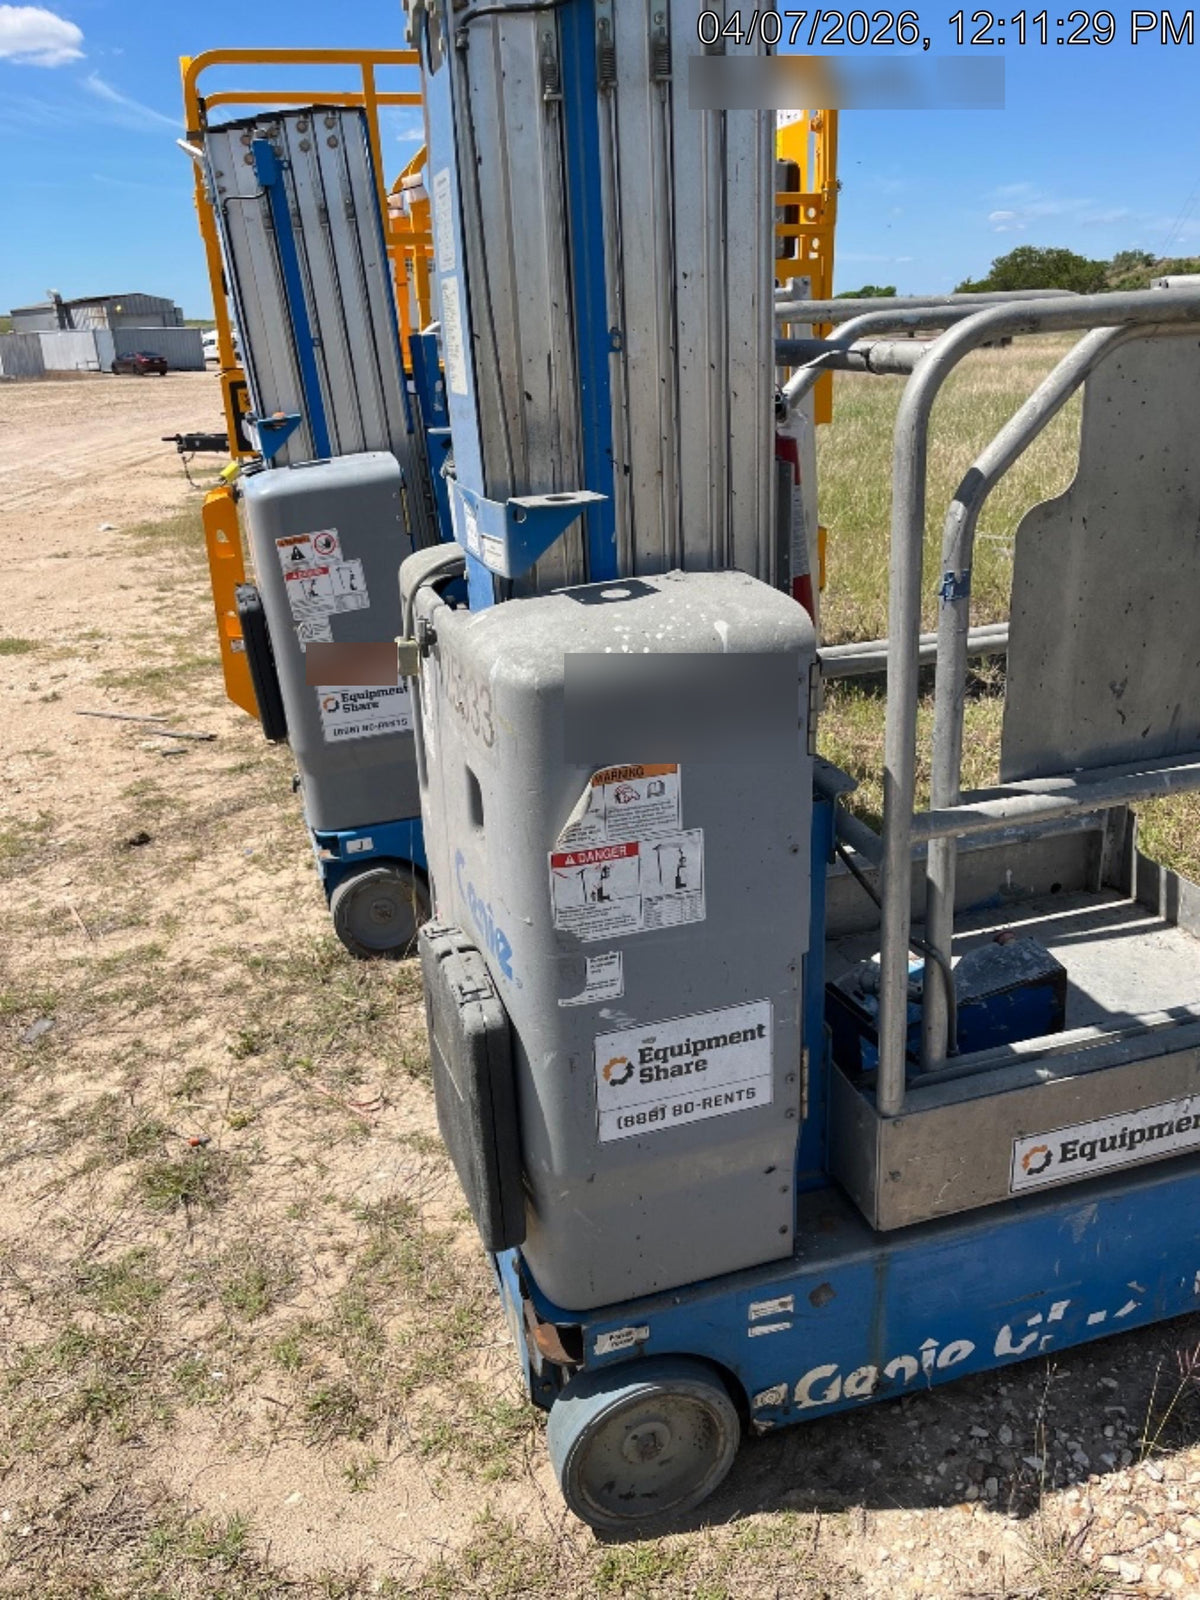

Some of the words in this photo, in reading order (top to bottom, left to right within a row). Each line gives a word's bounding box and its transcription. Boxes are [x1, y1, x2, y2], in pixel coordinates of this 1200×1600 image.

[577, 845, 627, 864] DANGER
[638, 1023, 767, 1065] Equipment
[639, 1058, 708, 1085] Share
[672, 1087, 757, 1118] 80-RENTS
